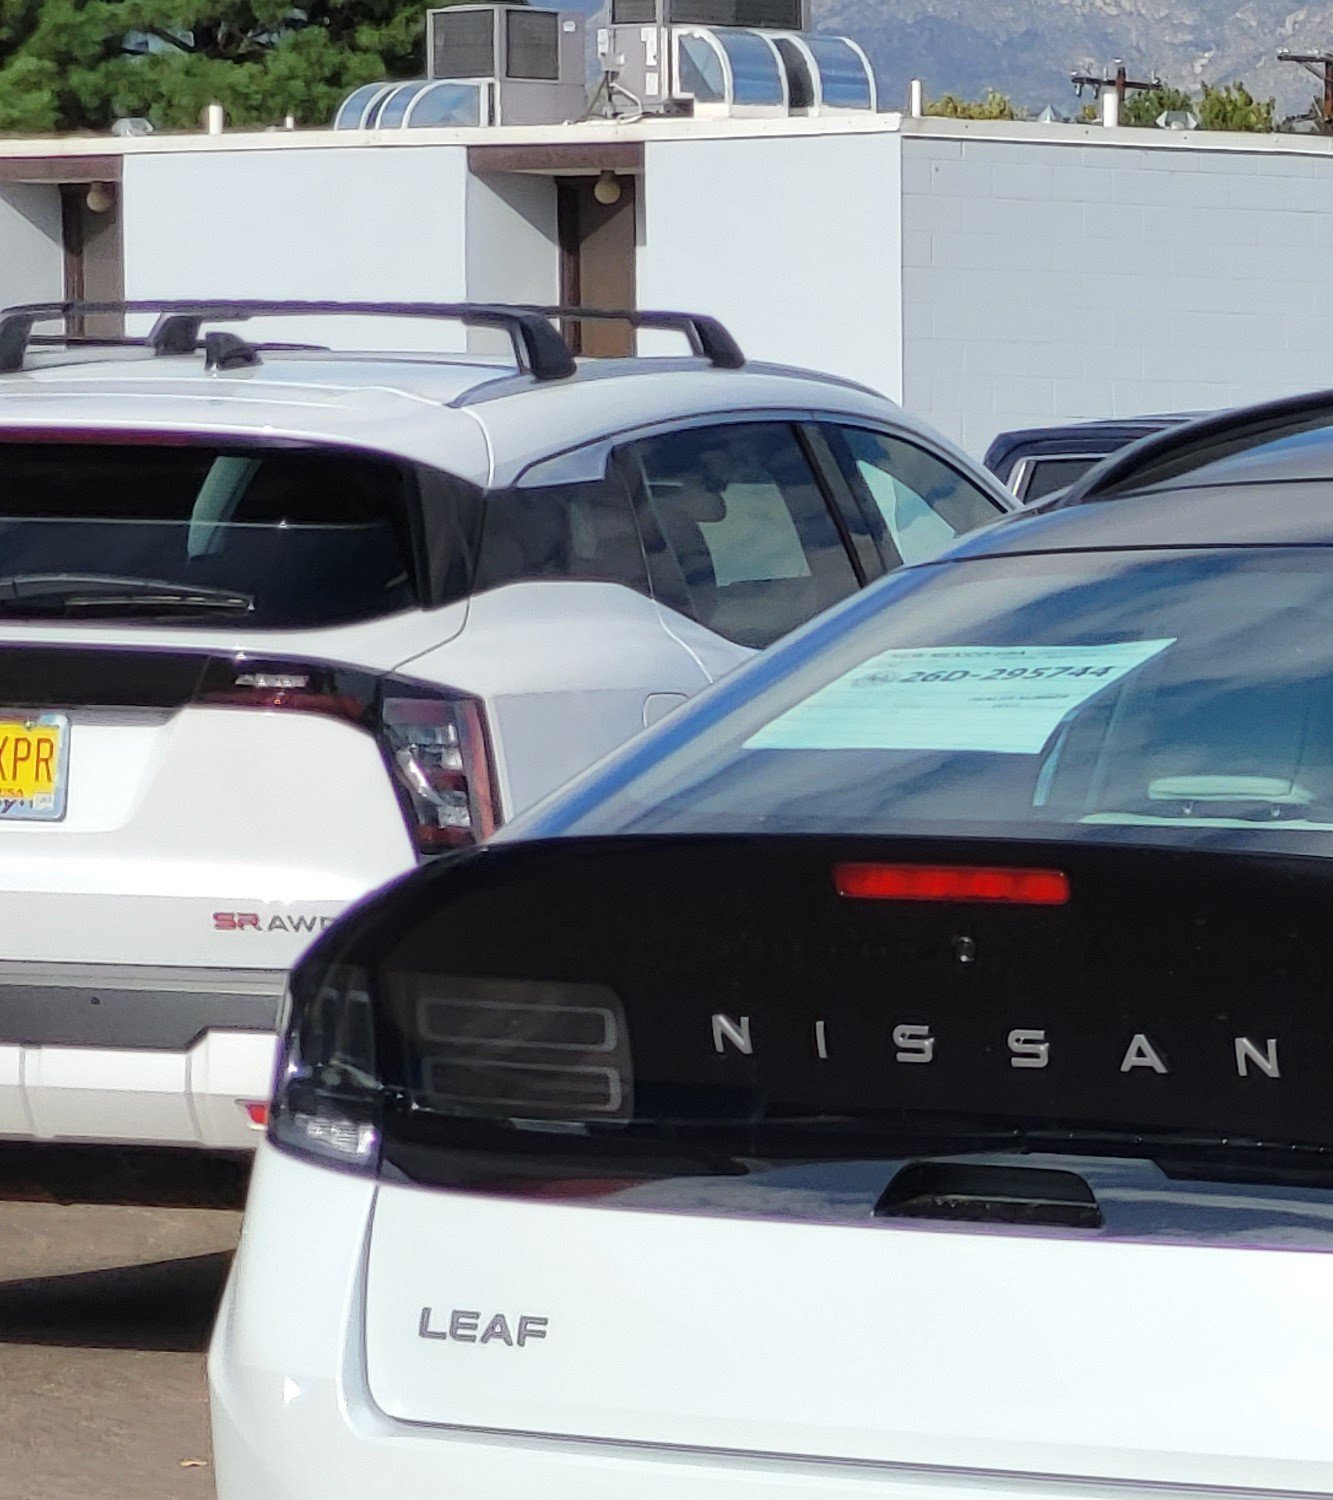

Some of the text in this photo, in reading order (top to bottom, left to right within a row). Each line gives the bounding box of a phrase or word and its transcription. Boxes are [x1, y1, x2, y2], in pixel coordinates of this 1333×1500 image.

[901, 665, 1113, 683] 26D-295744
[213, 912, 262, 931] SR
[711, 1013, 1280, 1078] NISSAN
[418, 1307, 549, 1347] LEAF
